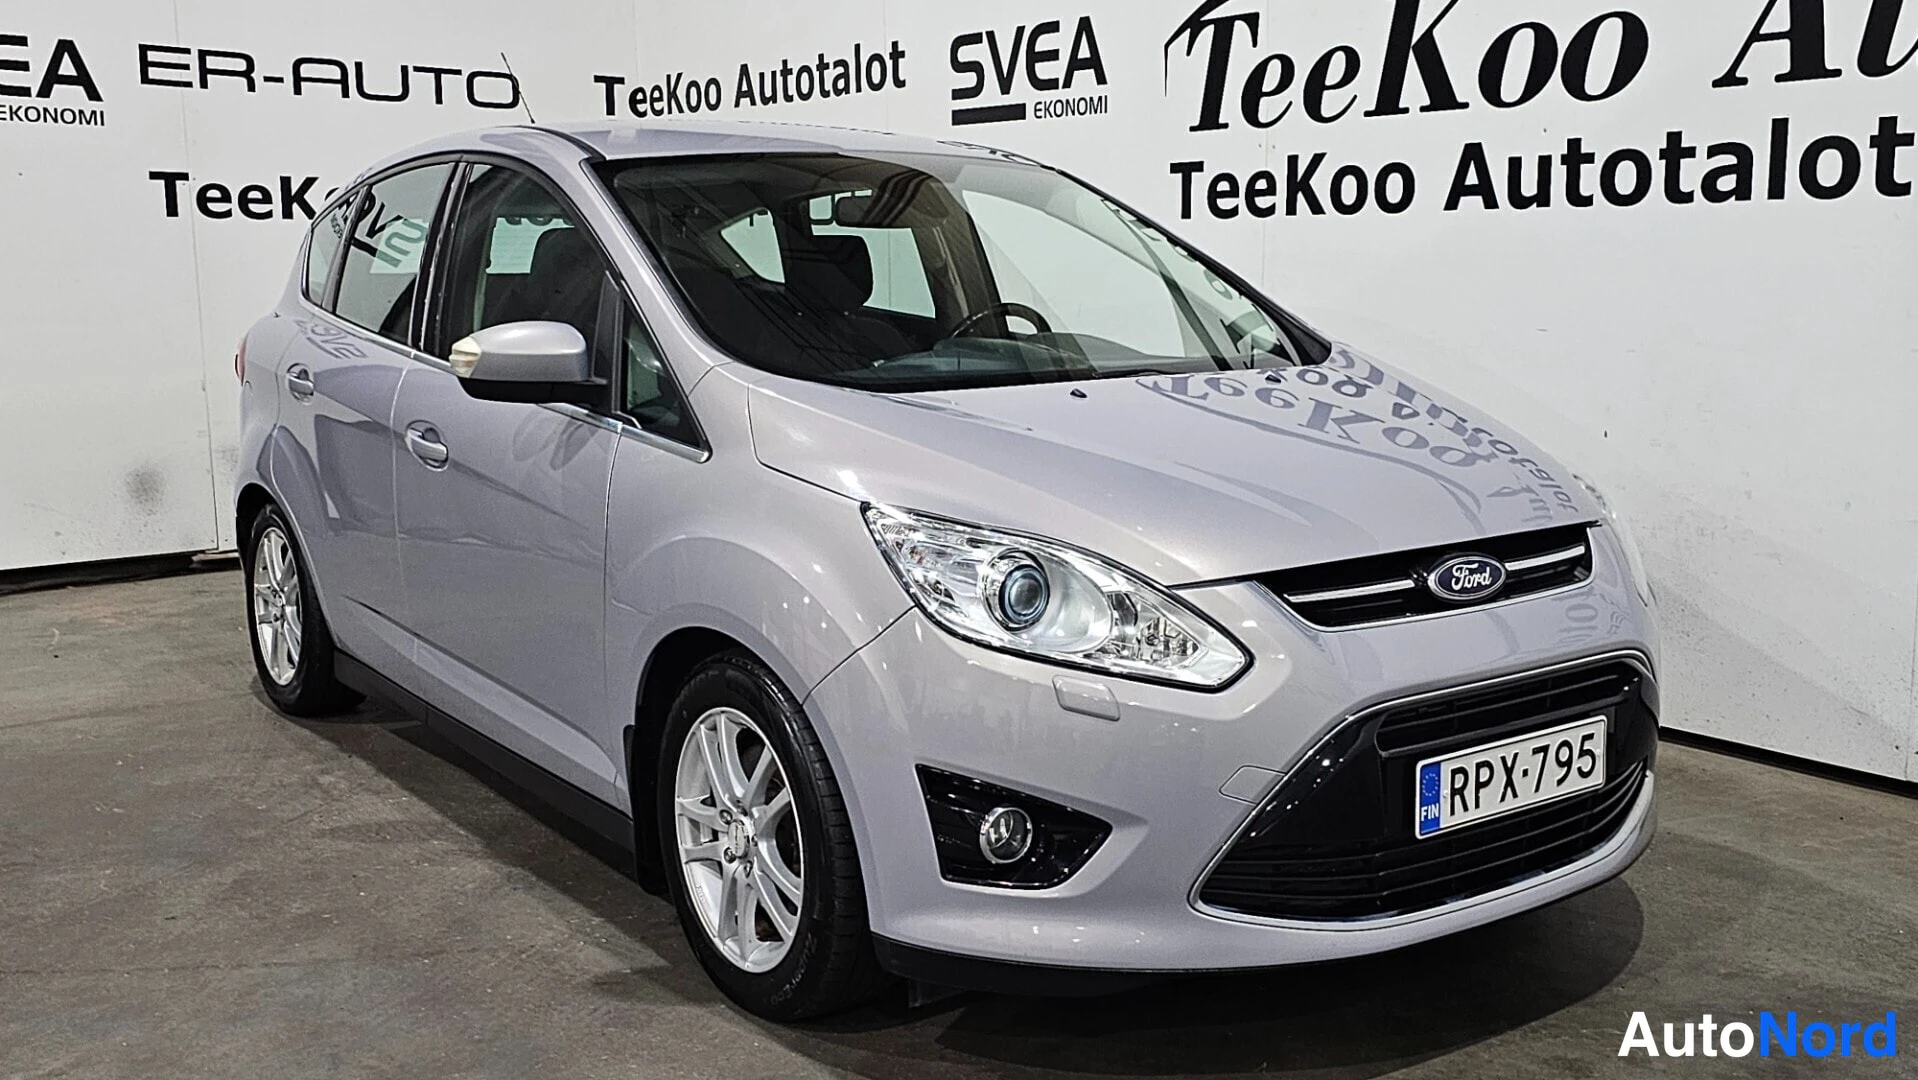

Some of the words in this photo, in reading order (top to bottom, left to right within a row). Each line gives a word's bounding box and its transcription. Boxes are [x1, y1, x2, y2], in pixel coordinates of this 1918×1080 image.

[138, 43, 522, 109] ER-AUTO
[593, 72, 722, 118] TeeKoo
[734, 40, 906, 108] Autotalot
[950, 15, 1108, 101] SVEA
[1180, 0, 1649, 132] TeeKoo
[1034, 95, 1108, 119] EKONOMI
[148, 170, 340, 221] TeeK
[1169, 152, 1415, 220] TeeKoo
[1443, 115, 1915, 212] Autotalot
[1451, 562, 1492, 591] Ford
[1420, 802, 1440, 822] FIN
